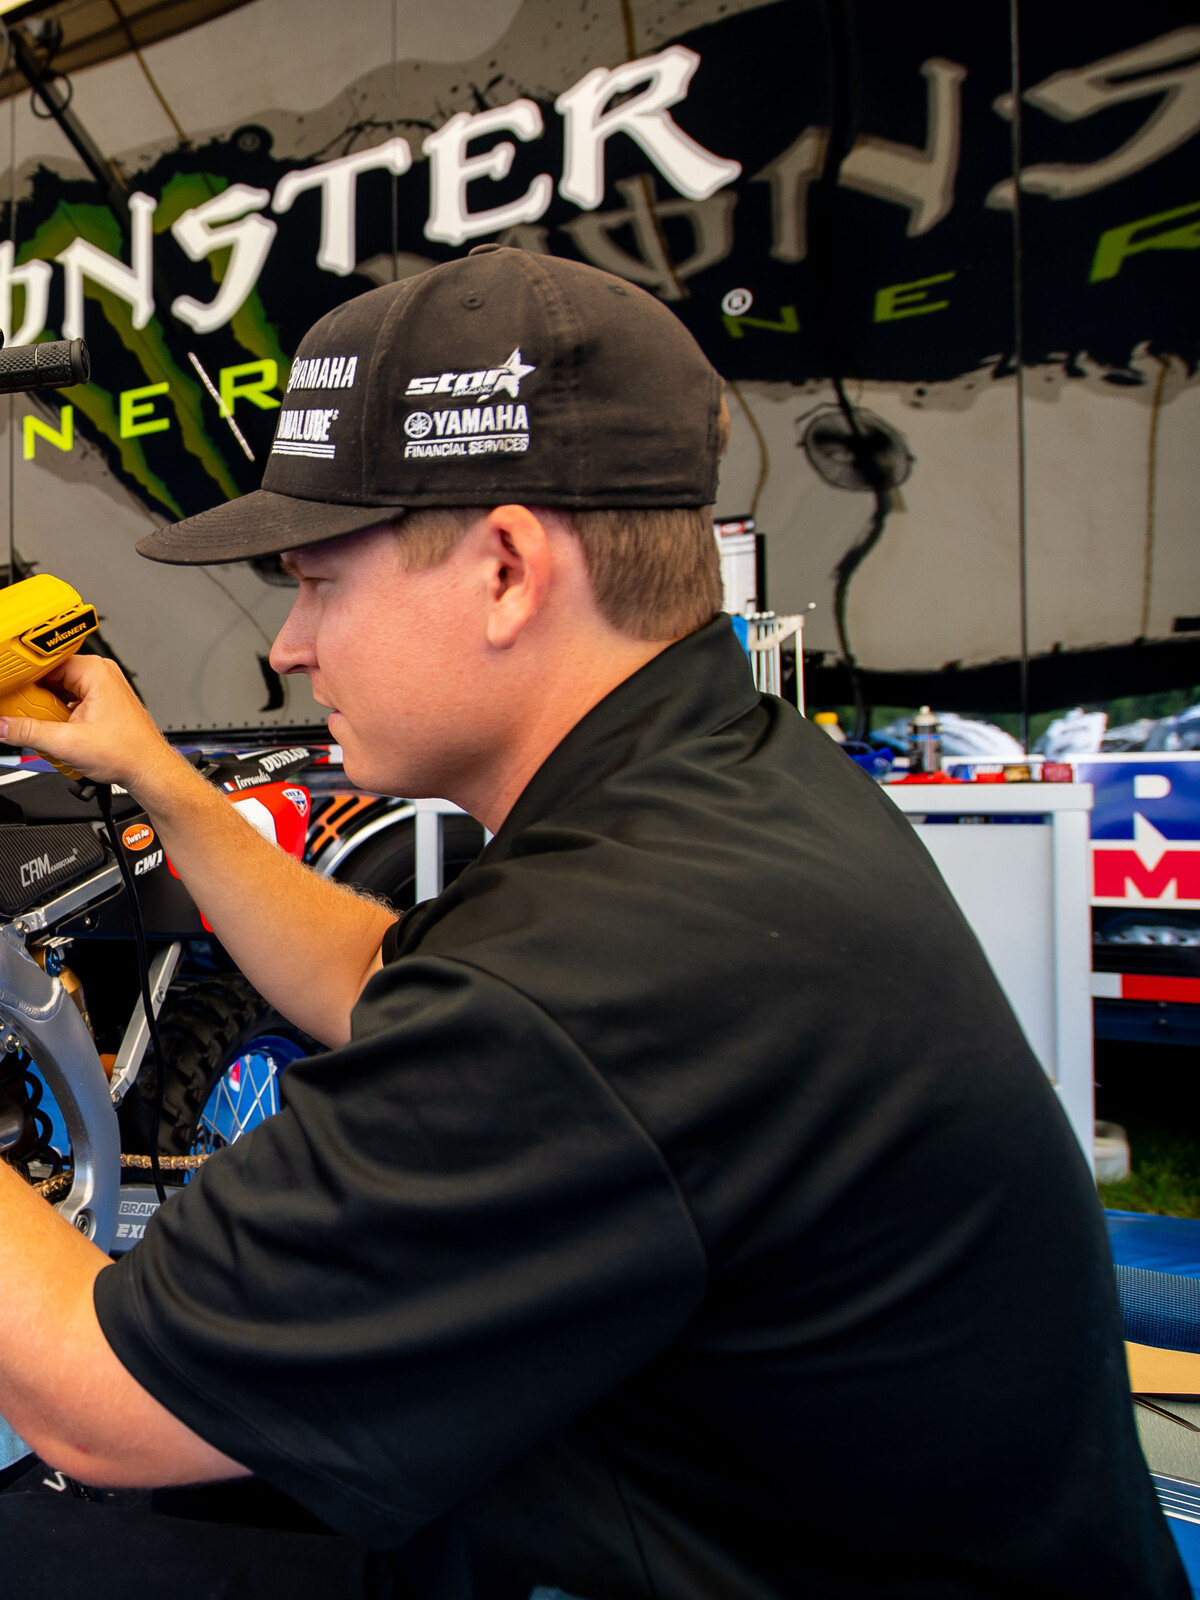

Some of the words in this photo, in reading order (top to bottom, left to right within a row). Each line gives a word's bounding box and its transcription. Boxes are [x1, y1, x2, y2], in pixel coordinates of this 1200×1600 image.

[294, 356, 358, 389] YAMAHA
[433, 404, 529, 436] YAMAHA
[404, 443, 467, 458] FINANCIAL
[468, 437, 530, 455] SERVICES
[46, 622, 87, 648] WAGNER
[259, 746, 311, 773] DUNLOP
[20, 853, 51, 887] CRM
[119, 1201, 160, 1216] BRAK
